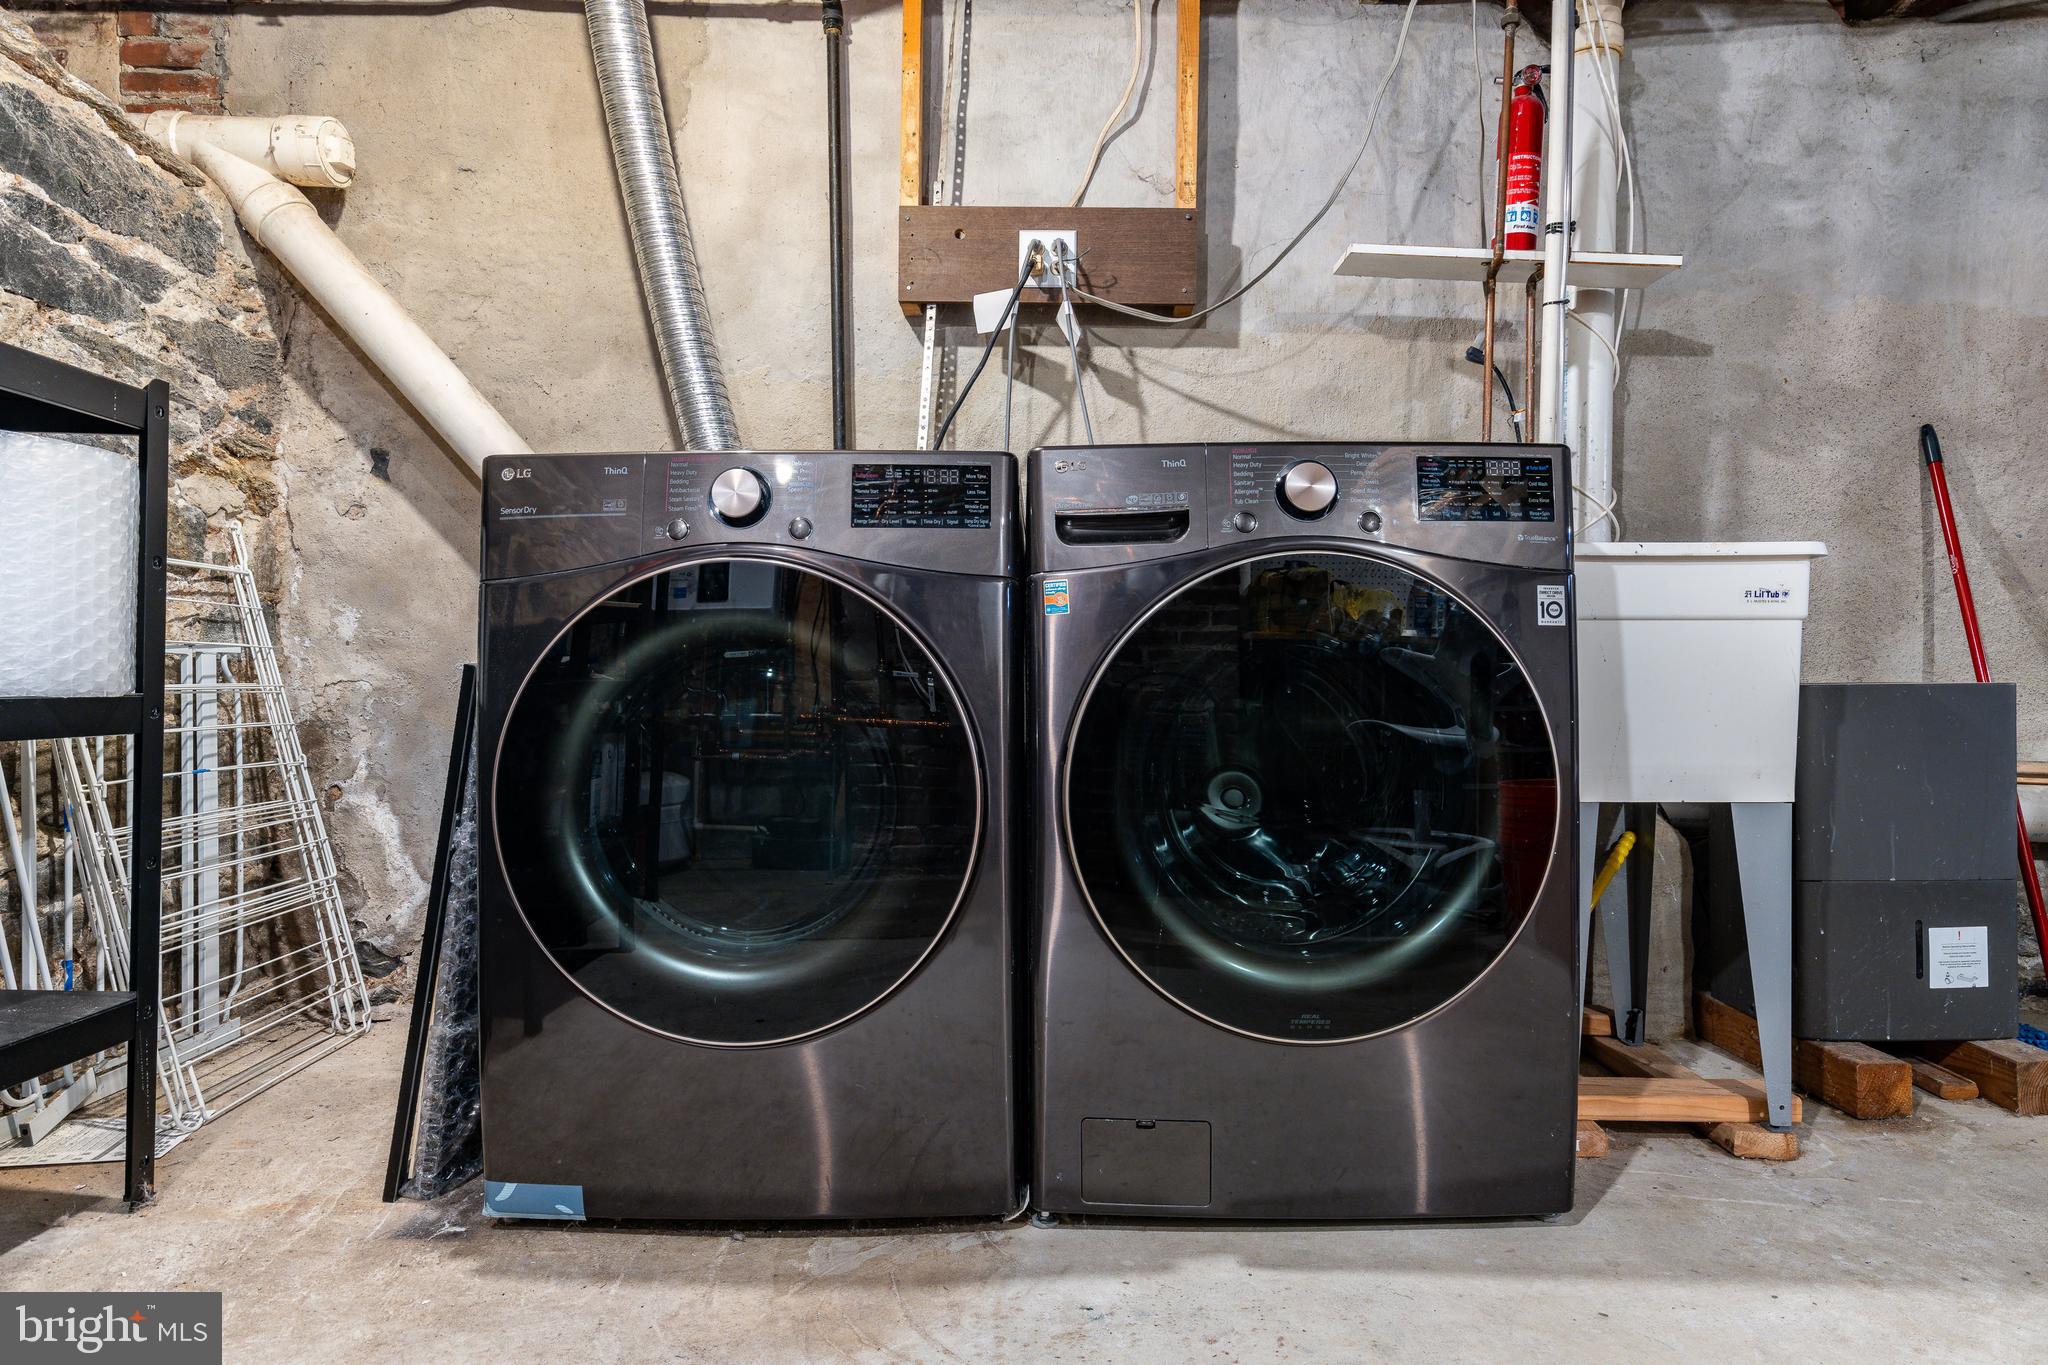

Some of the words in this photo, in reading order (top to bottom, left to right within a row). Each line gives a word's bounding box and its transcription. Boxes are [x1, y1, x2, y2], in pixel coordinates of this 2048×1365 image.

[1344, 452, 1360, 460] Bright
[1161, 459, 1186, 468] ThinQ
[516, 469, 532, 479] LG
[604, 466, 629, 476] ThinQ
[1540, 601, 1564, 619] 10
